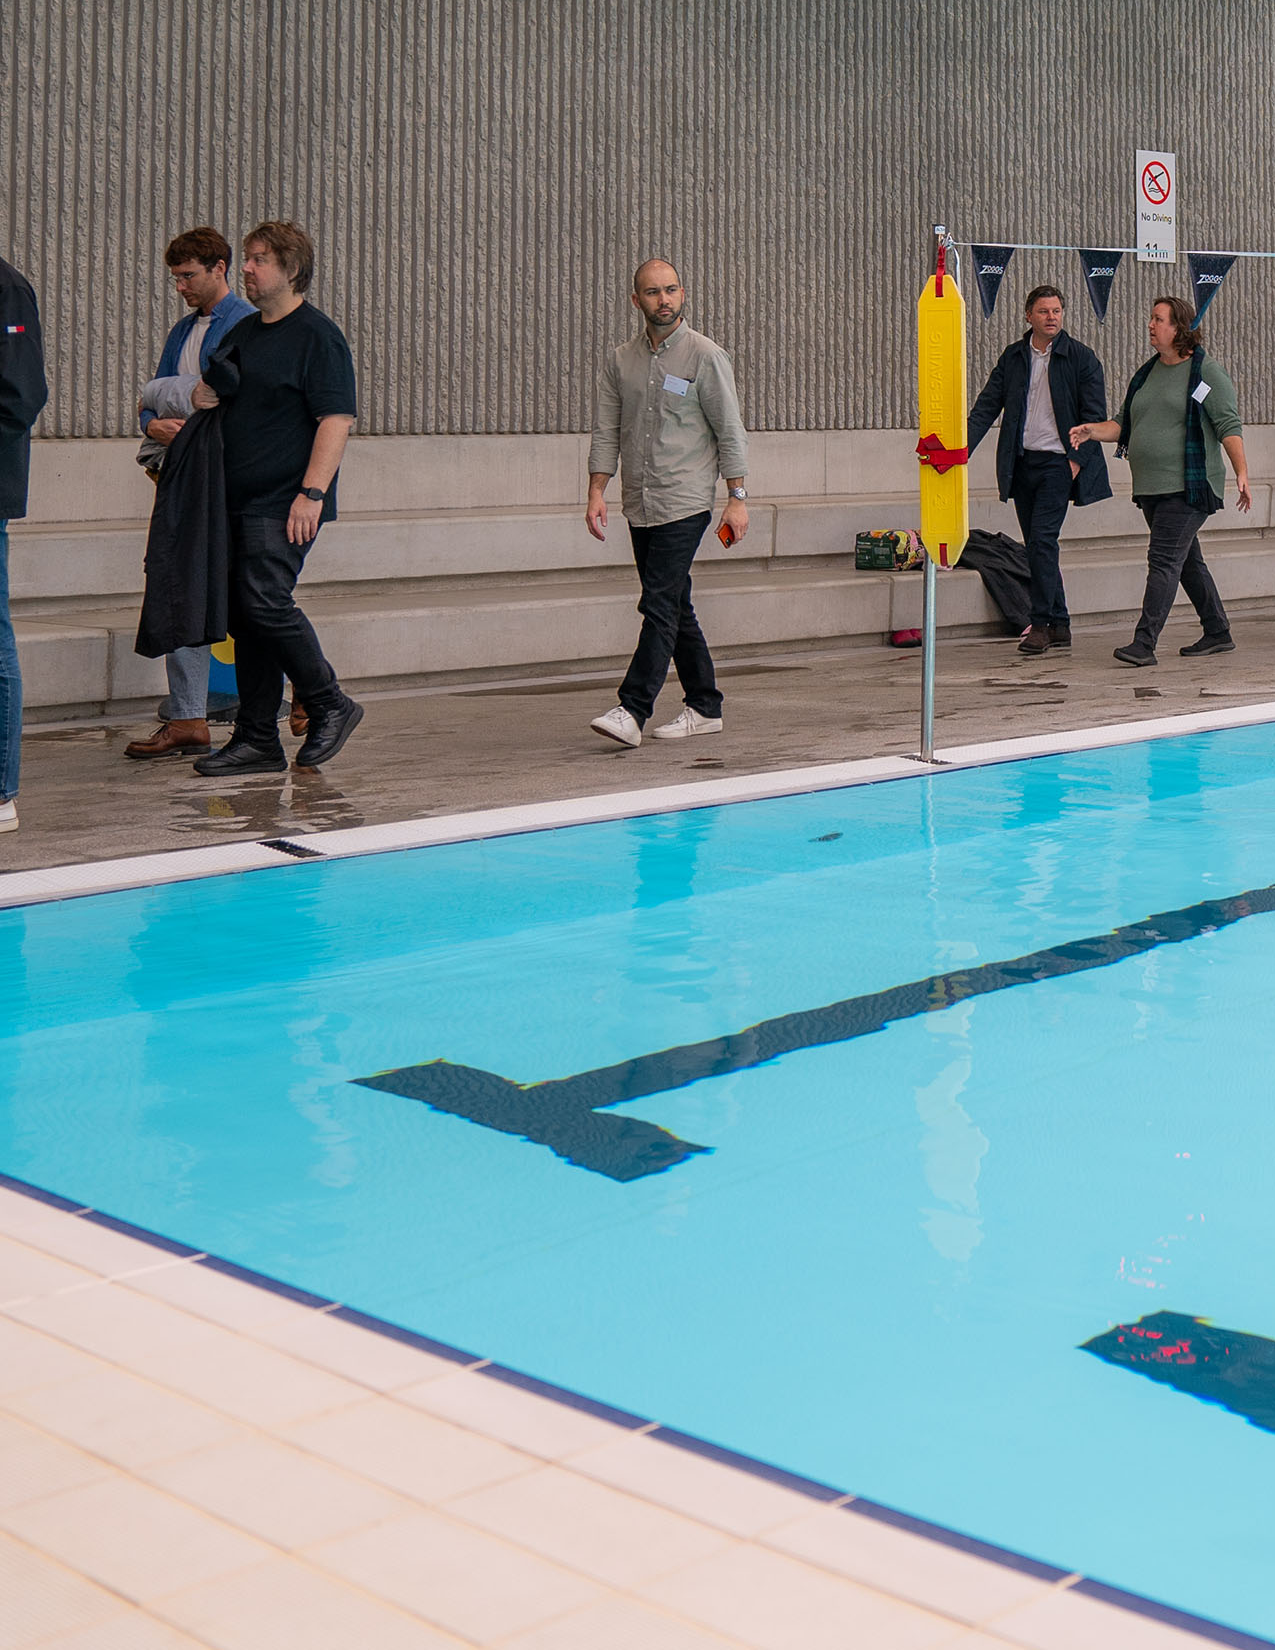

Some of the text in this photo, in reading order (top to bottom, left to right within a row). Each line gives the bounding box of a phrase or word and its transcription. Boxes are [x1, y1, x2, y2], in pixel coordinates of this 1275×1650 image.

[1141, 211, 1173, 225] No Diving
[1196, 274, 1223, 285] ZOGGS
